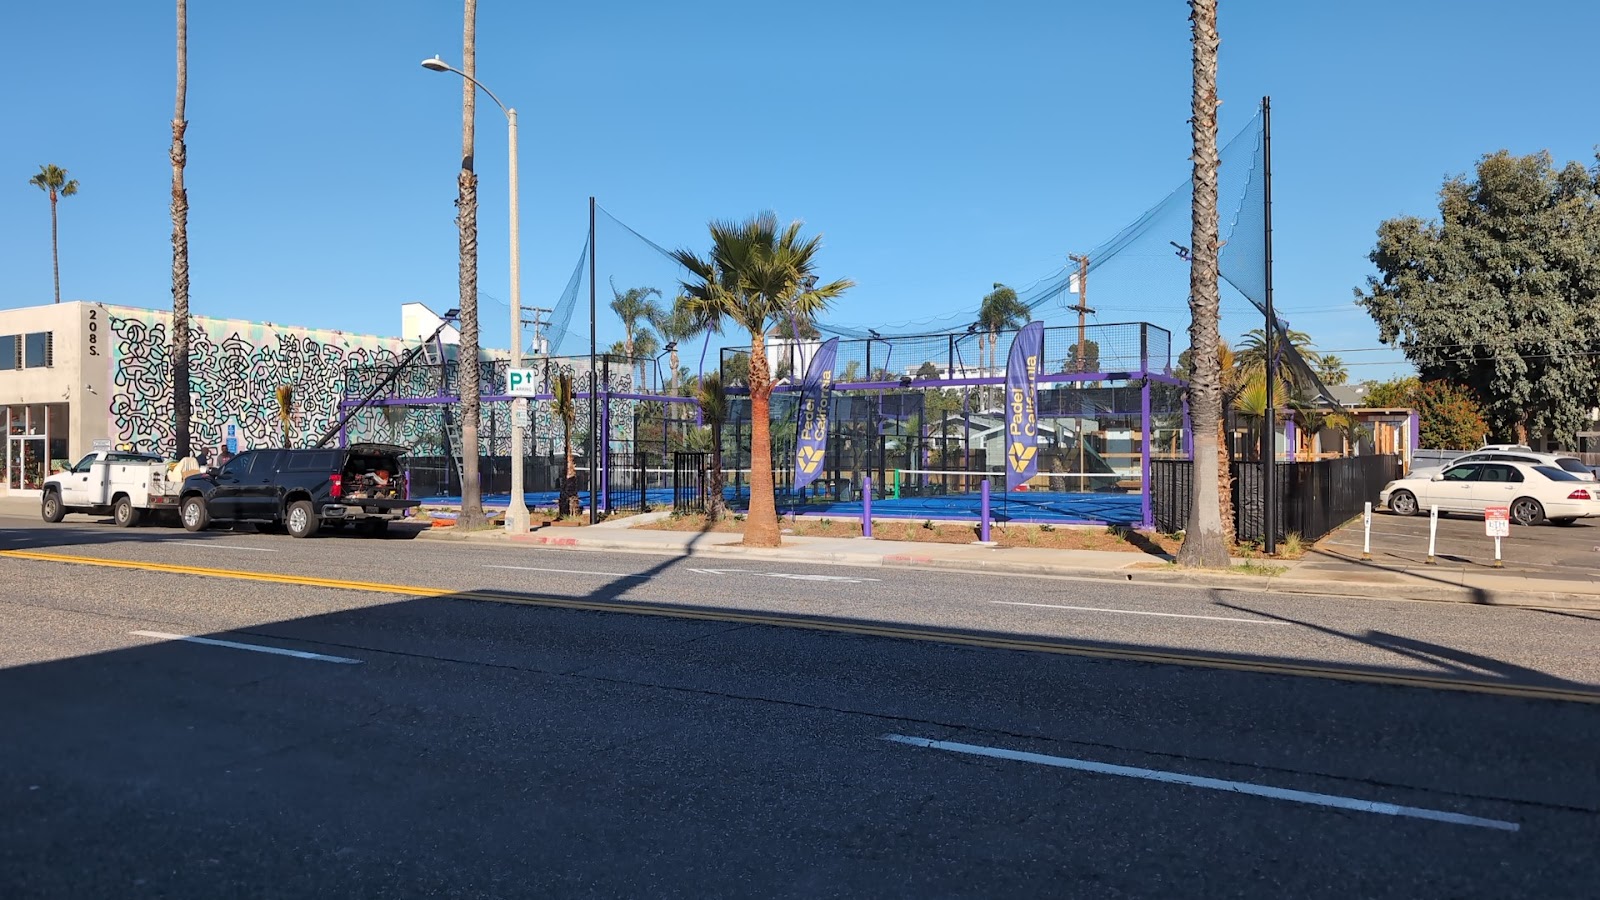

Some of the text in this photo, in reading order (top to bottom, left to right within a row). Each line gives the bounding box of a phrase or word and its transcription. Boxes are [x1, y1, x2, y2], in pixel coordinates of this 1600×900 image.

[89, 309, 100, 356] 208 S.
[801, 398, 815, 441] Padel
[814, 371, 832, 442] California
[1010, 388, 1023, 436] Padel
